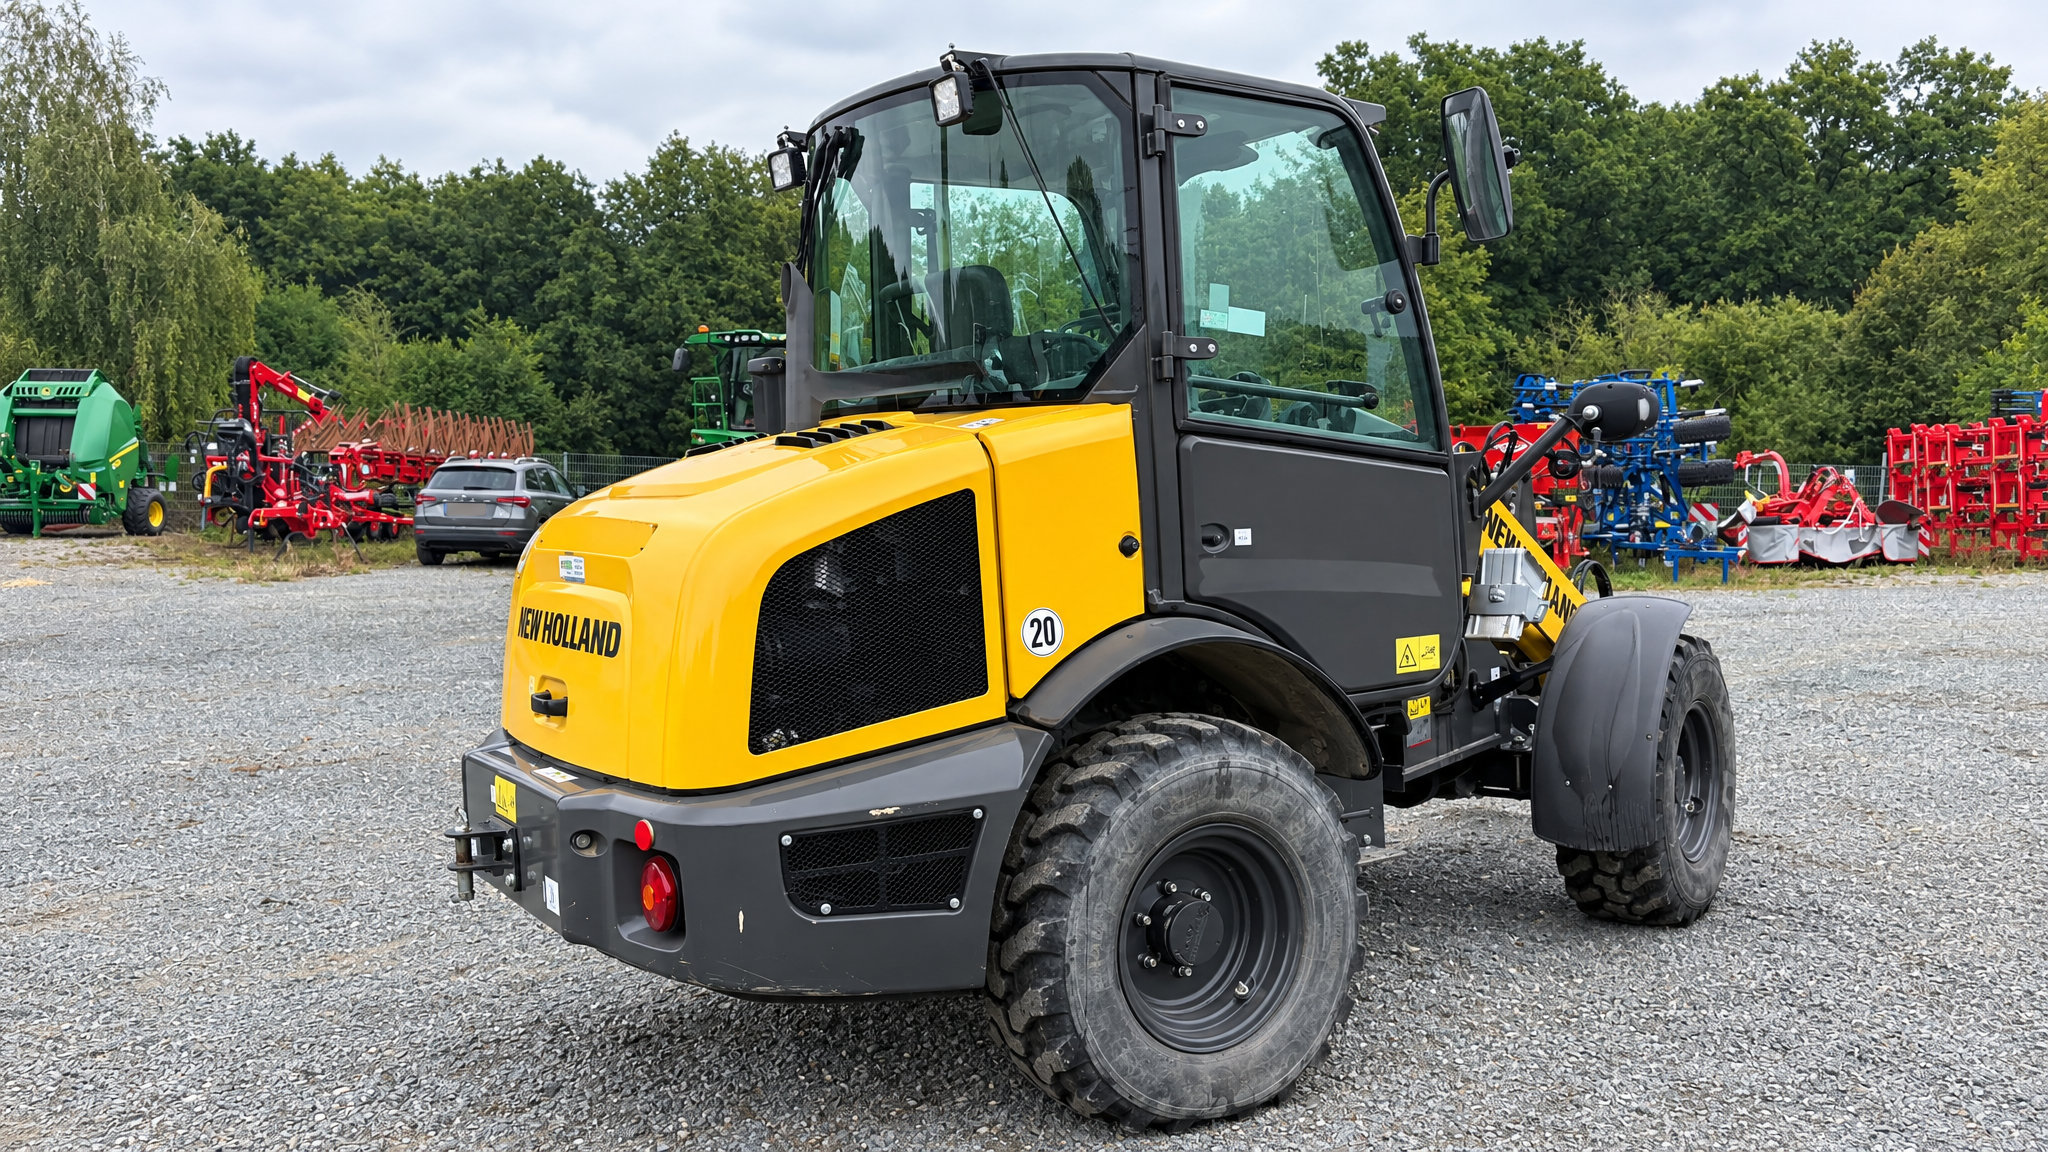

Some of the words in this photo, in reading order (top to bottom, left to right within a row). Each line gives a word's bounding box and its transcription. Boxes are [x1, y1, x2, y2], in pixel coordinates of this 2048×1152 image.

[517, 606, 543, 642] NEW
[541, 611, 622, 658] HOLLAND
[1029, 616, 1056, 649] 20
